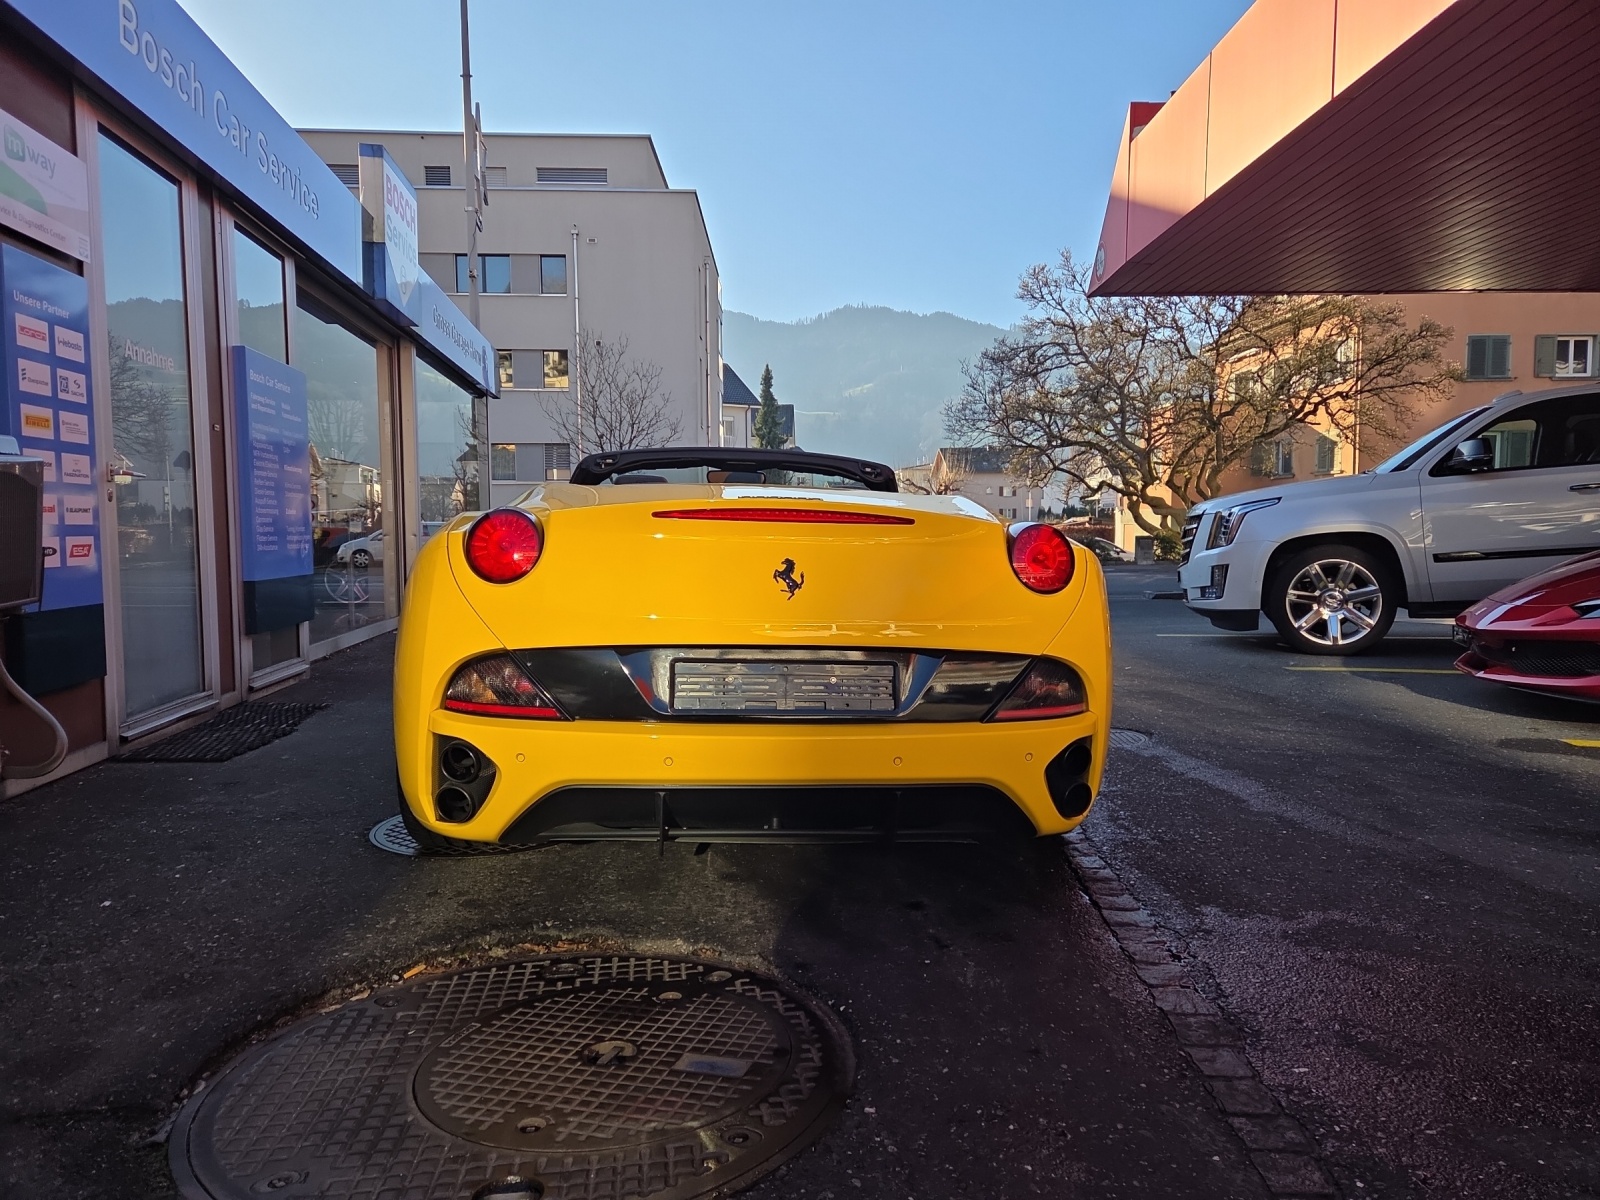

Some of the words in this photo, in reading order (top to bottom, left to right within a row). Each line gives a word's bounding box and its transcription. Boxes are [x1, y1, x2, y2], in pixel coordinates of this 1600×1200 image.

[118, 0, 205, 119] Bosch
[213, 90, 251, 157] Car
[257, 131, 320, 220] Service
[385, 173, 416, 236] BOSCH
[50, 227, 66, 242] Center
[386, 214, 418, 269] Service
[13, 289, 41, 310] Unsere
[42, 301, 69, 319] Partner
[57, 336, 82, 352] Webasto
[125, 339, 174, 372] Annahme
[451, 322, 470, 359] Garage
[249, 369, 265, 385] Bosch
[265, 376, 274, 388] Car
[274, 379, 291, 394] Service
[25, 414, 50, 429] PIRELLI
